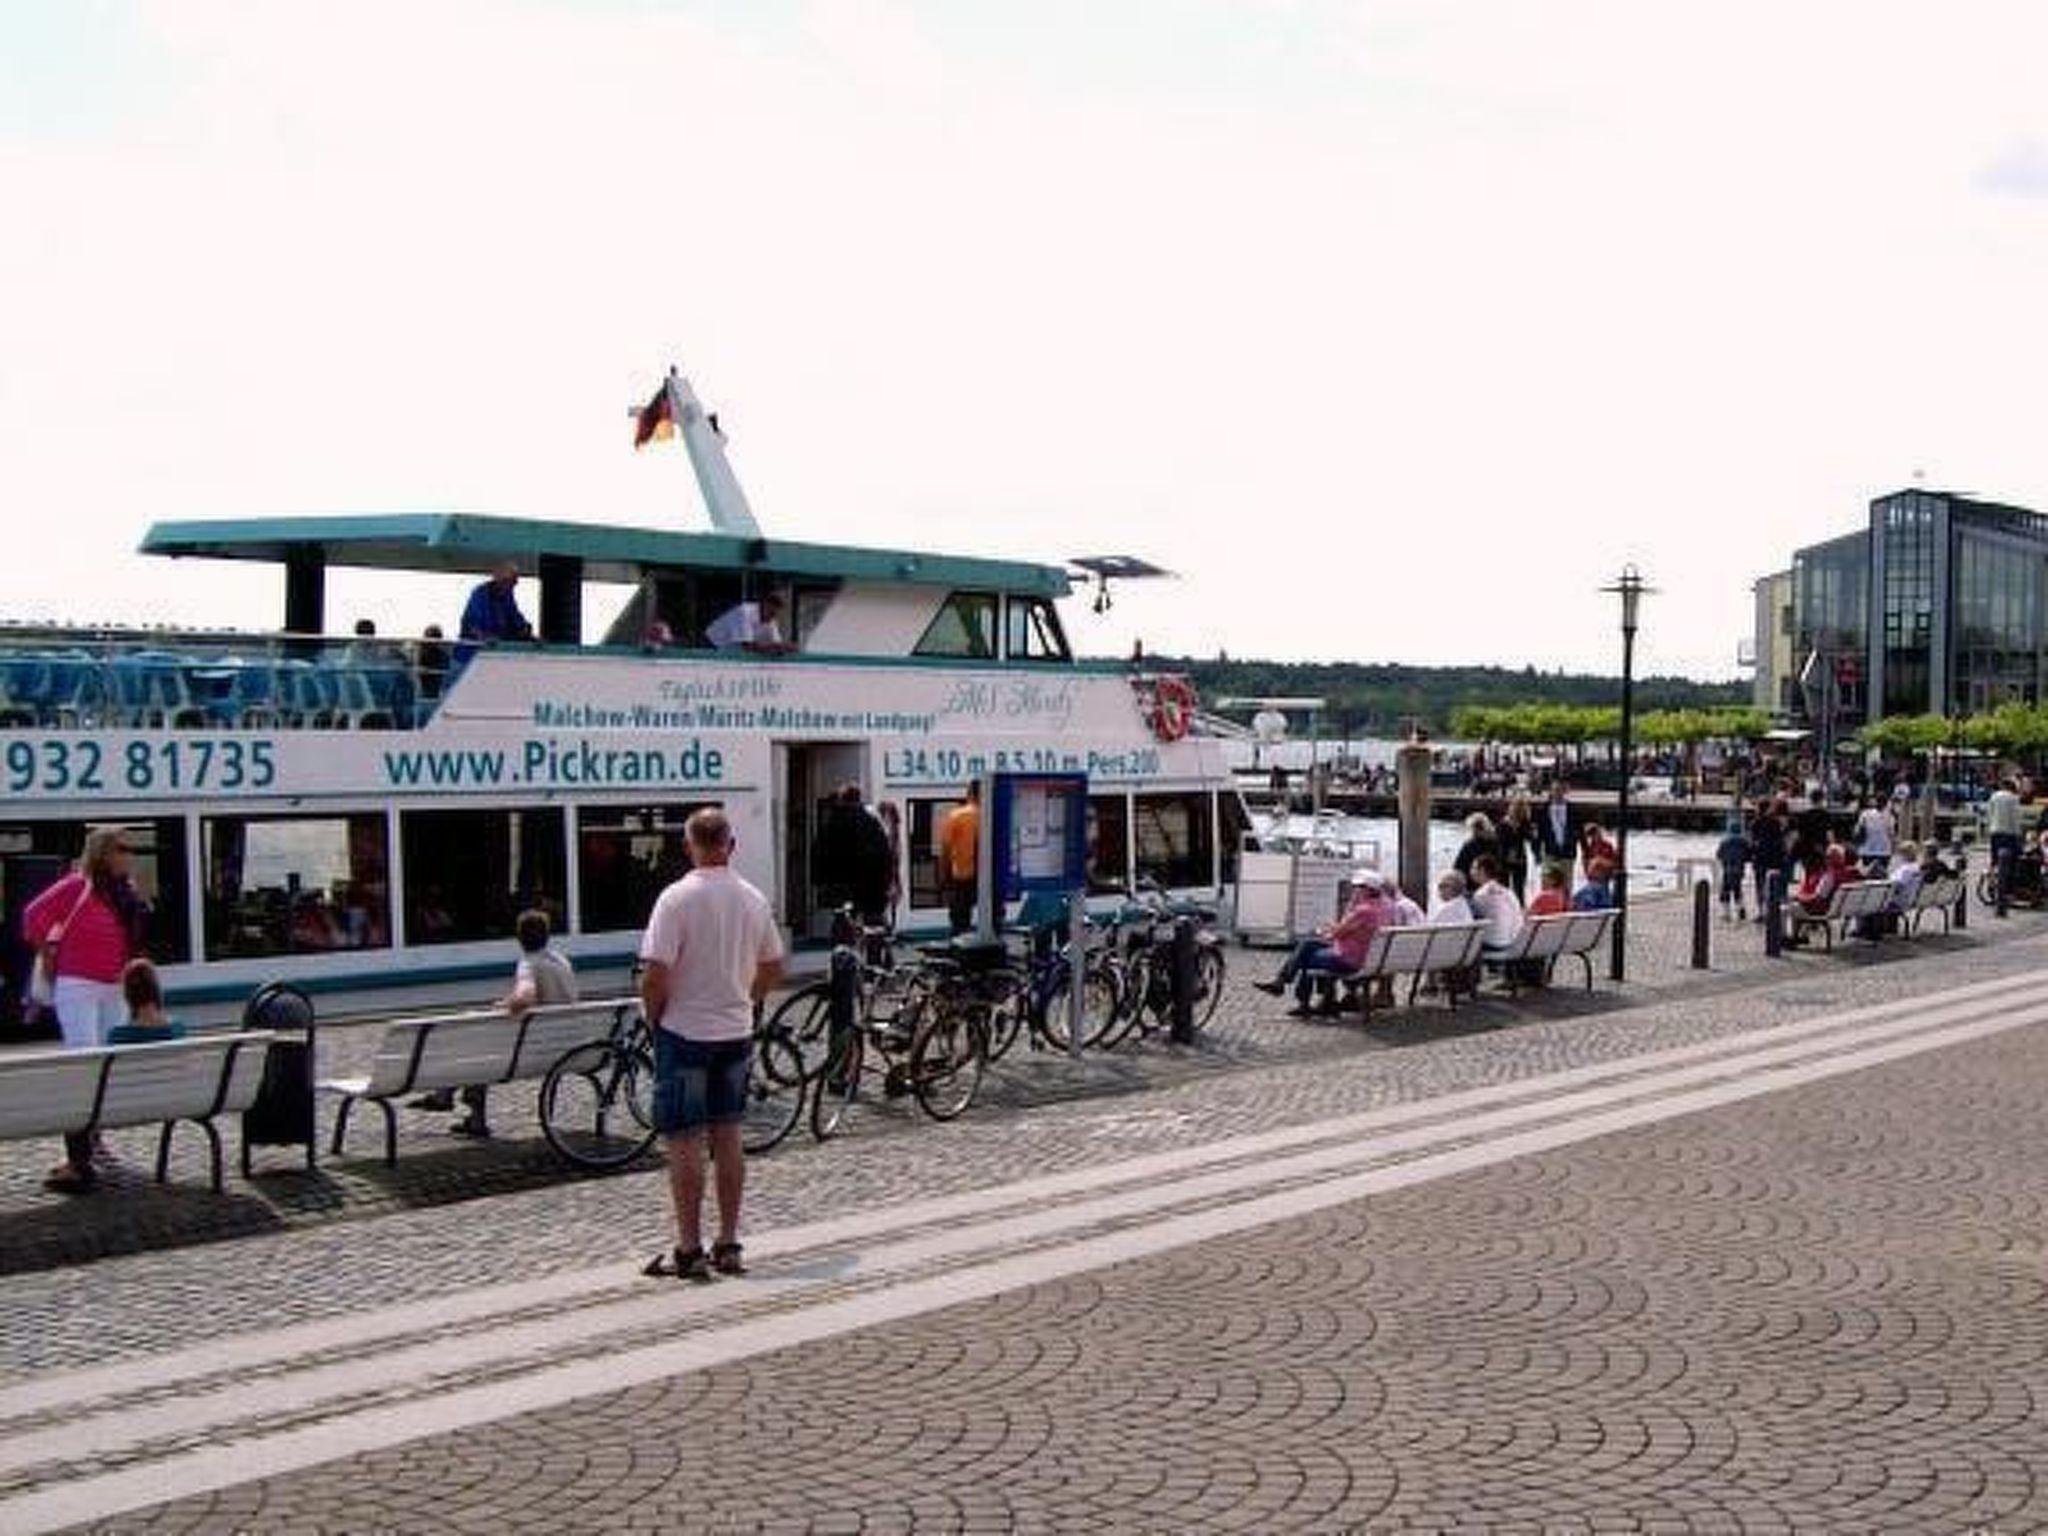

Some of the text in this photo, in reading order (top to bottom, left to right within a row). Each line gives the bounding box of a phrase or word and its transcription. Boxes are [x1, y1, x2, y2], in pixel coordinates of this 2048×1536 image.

[7, 740, 275, 792] 932 81735
[385, 738, 723, 785] www.Pickran.de
[966, 755, 986, 775] m
